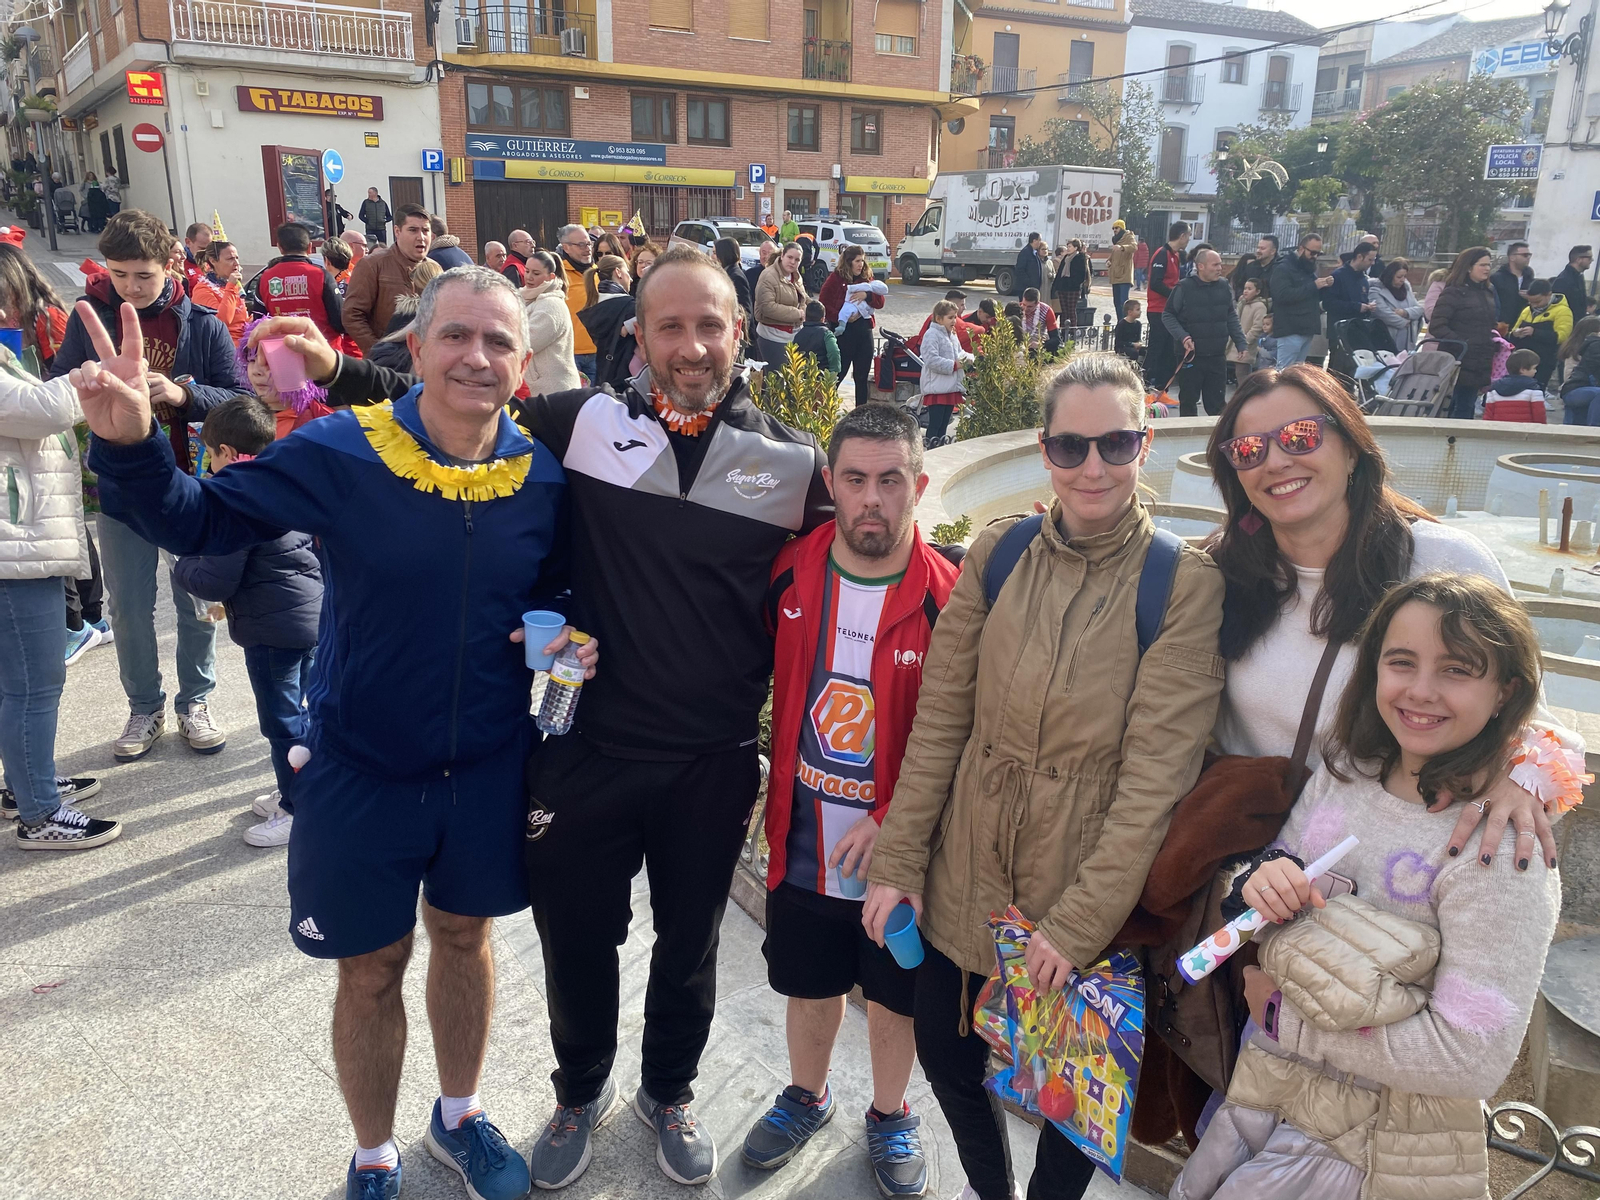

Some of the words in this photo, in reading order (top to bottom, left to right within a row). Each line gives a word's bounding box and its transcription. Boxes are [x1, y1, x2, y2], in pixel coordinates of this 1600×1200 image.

[278, 91, 373, 111] TABACOS
[506, 139, 576, 153] GUTIÉRREZ
[615, 146, 625, 154] 953
[426, 151, 439, 169] P
[548, 168, 585, 178] CORREOS
[653, 172, 687, 182] CORREOS
[752, 166, 763, 182] P
[878, 182, 906, 191] CORREOS
[1067, 190, 1113, 208] TOXI
[1066, 207, 1113, 226] MUEBLES
[284, 283, 309, 296] ALBOR
[726, 468, 757, 485] Sugar
[756, 473, 781, 489] Ray
[531, 809, 555, 826] Ray
[297, 925, 325, 941] adidas
